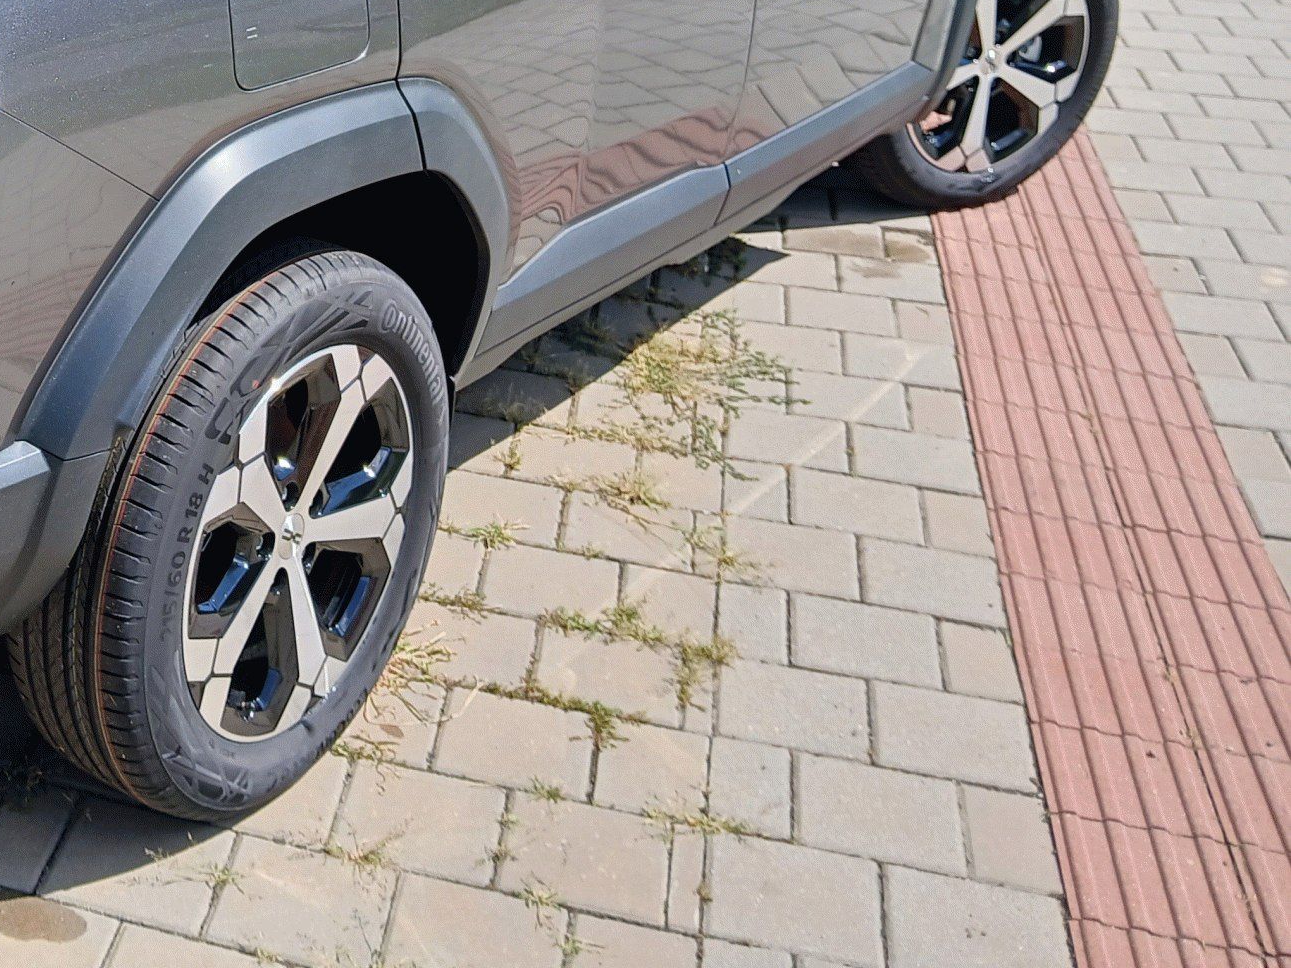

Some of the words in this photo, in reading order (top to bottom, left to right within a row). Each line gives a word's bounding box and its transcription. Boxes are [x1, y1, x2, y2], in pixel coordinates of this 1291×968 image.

[379, 299, 445, 406] Continental
[198, 463, 214, 485] H
[185, 492, 203, 518] 18
[177, 526, 194, 543] R
